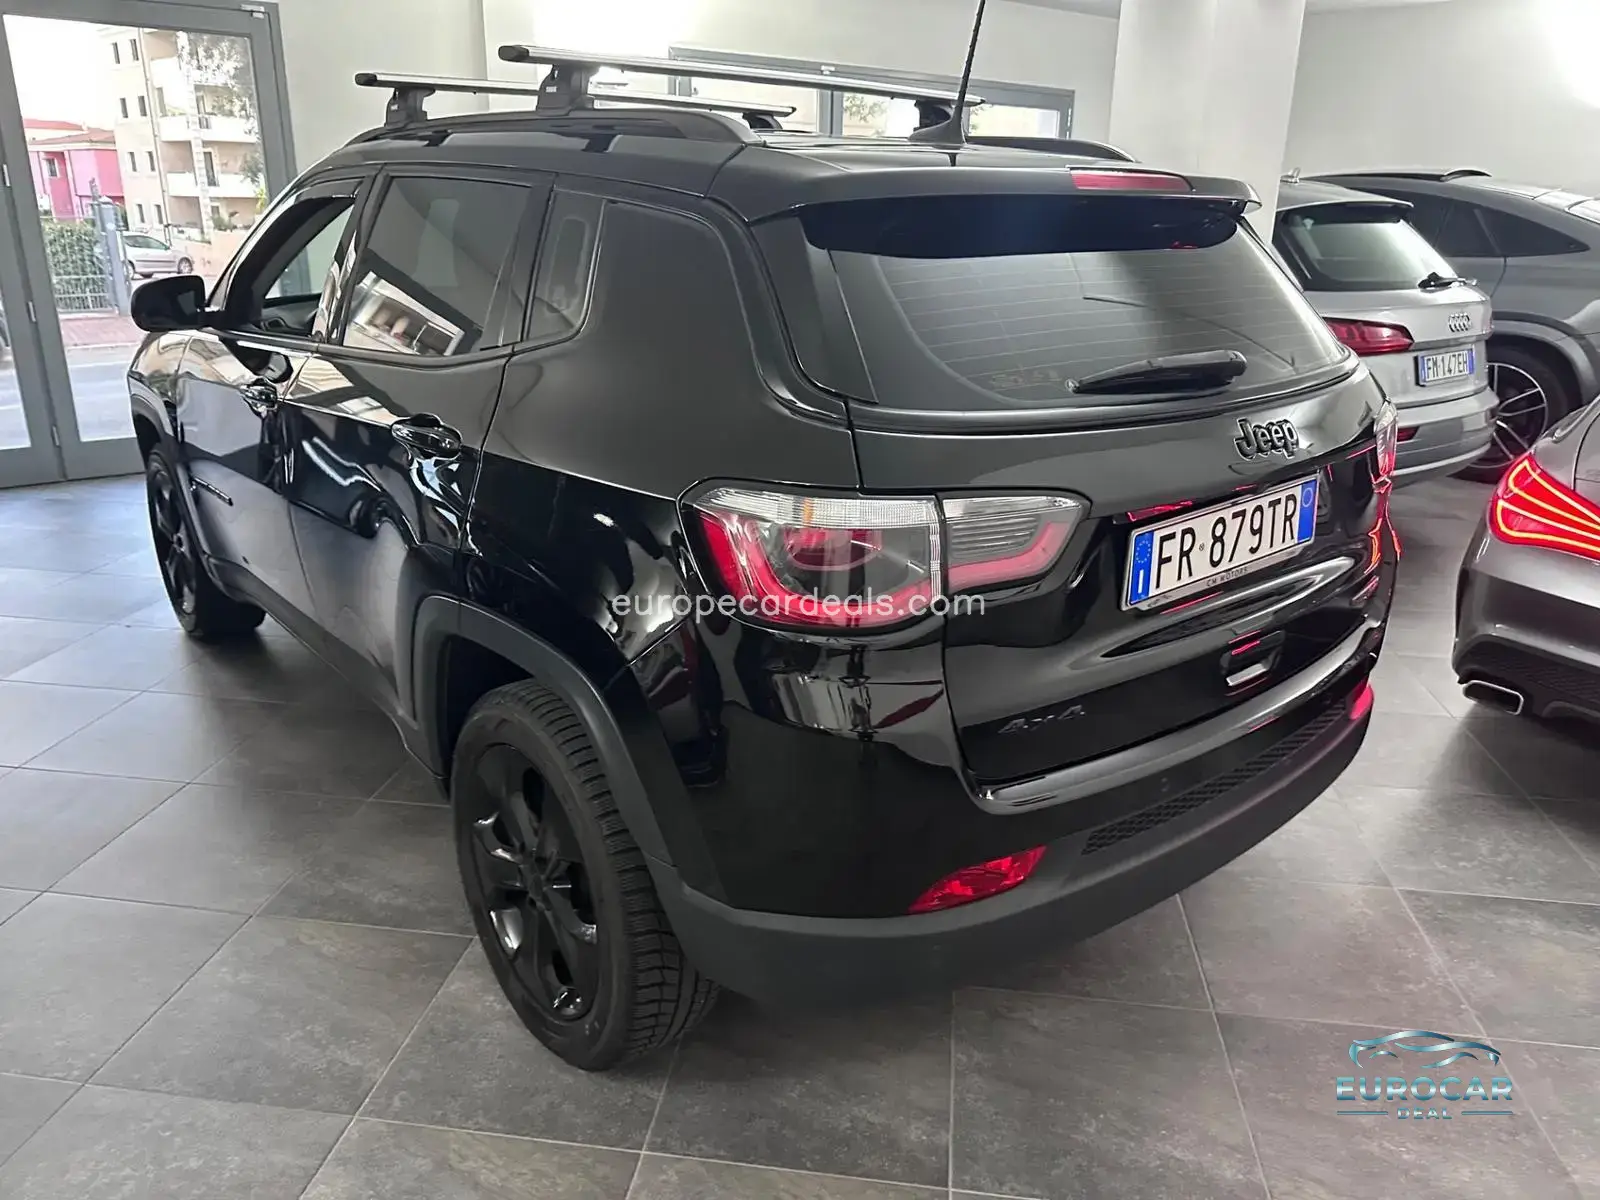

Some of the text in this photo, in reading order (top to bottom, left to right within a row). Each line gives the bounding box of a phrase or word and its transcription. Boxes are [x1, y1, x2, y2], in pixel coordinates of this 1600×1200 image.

[1426, 351, 1468, 379] FM 147EH
[1234, 417, 1300, 461] Jeep
[1155, 493, 1298, 590] FR 879TR
[1206, 578, 1218, 587] CM
